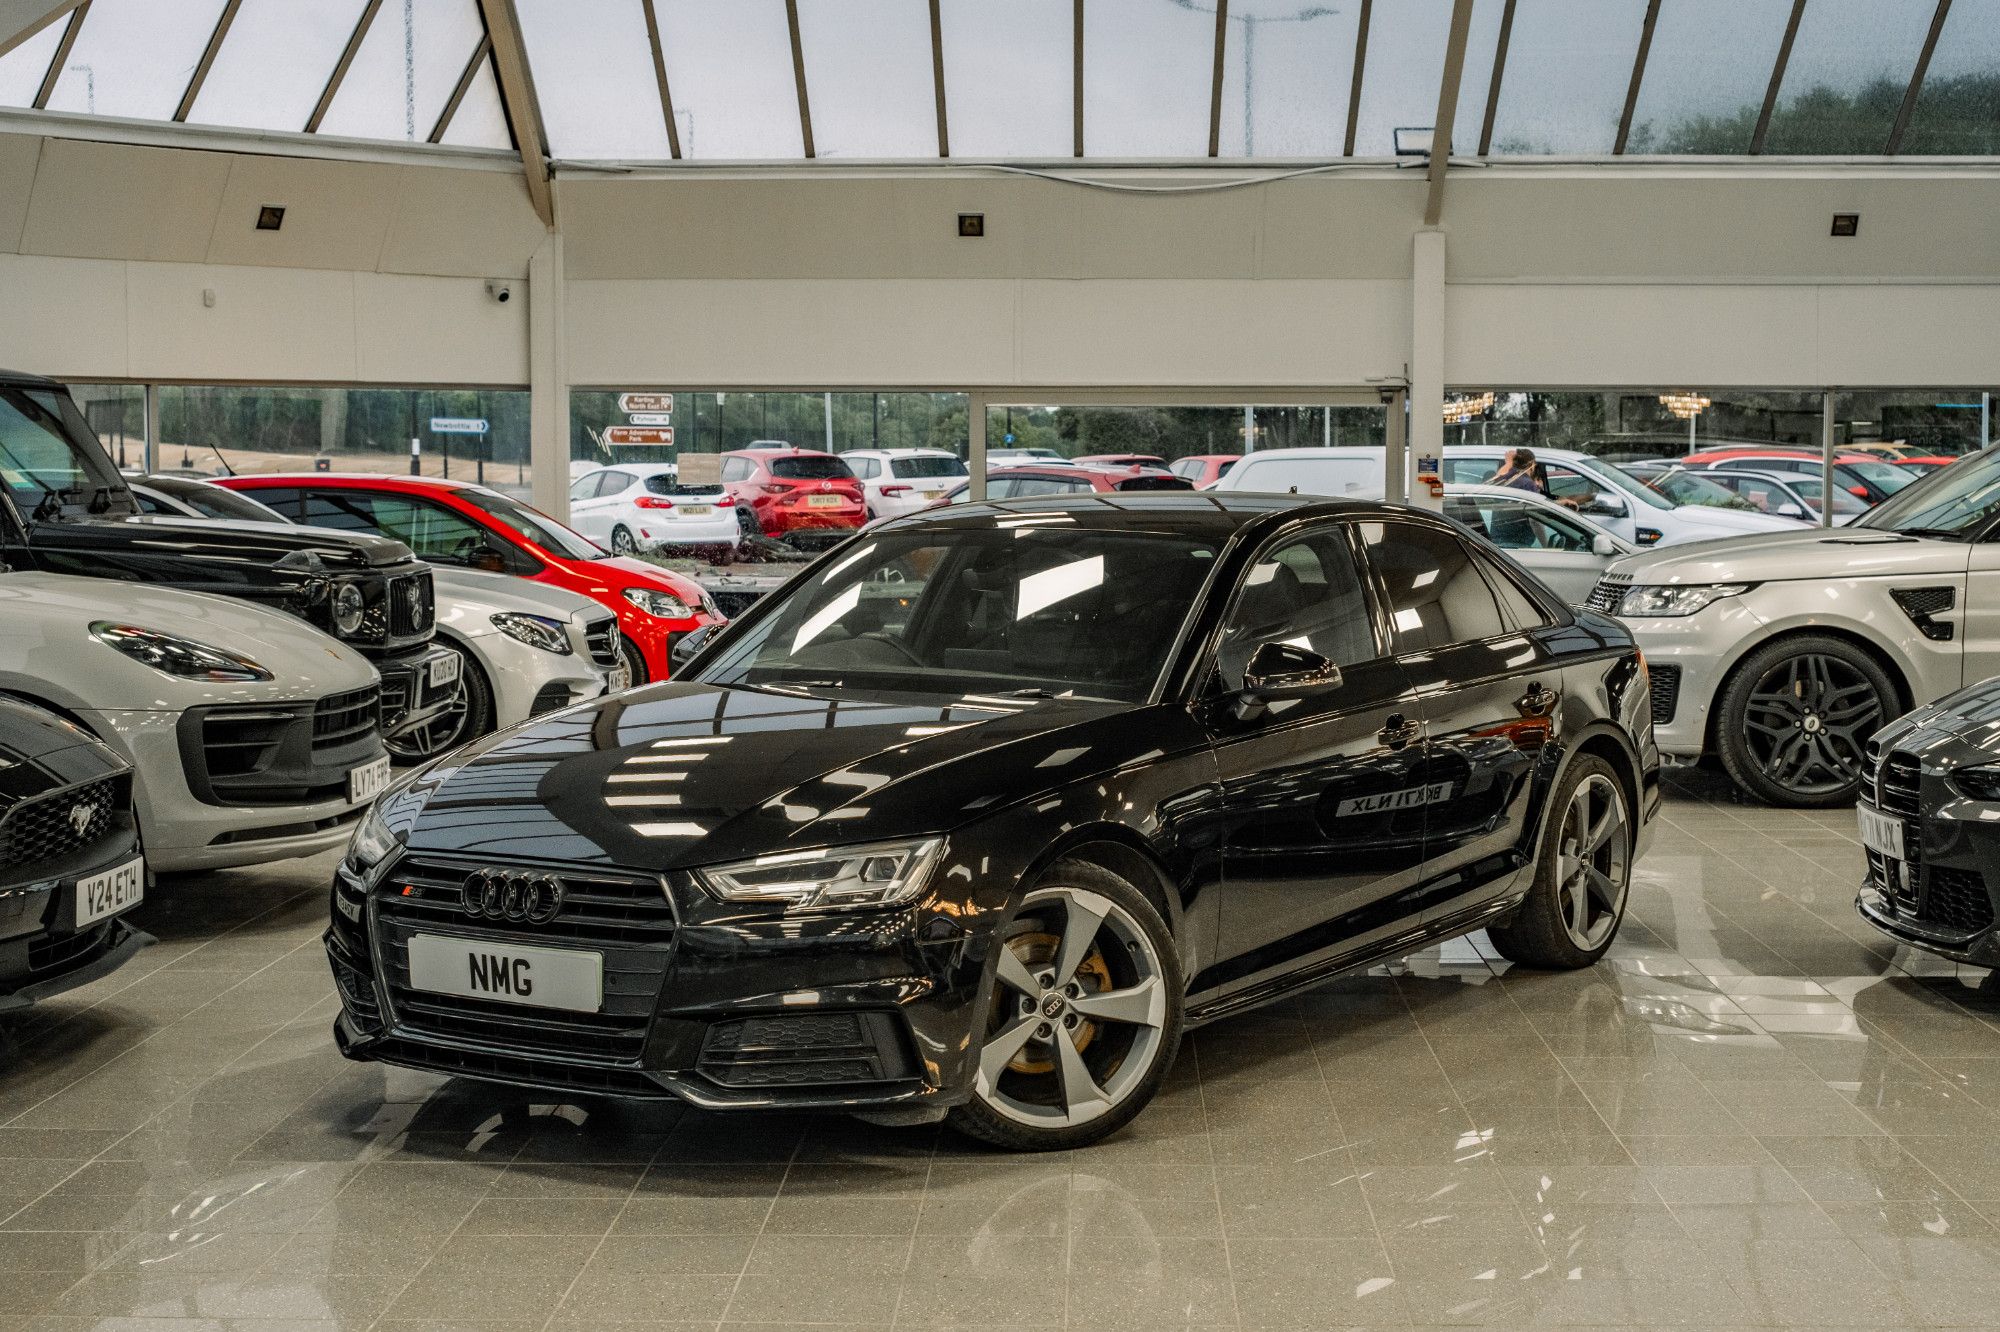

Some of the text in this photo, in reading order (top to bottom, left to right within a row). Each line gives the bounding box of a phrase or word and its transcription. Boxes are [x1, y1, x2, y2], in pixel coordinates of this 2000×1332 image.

[355, 766, 375, 798] LY74
[1875, 817, 1896, 853] NJX
[88, 866, 137, 916] V24 ETH
[468, 952, 533, 997] NMG
